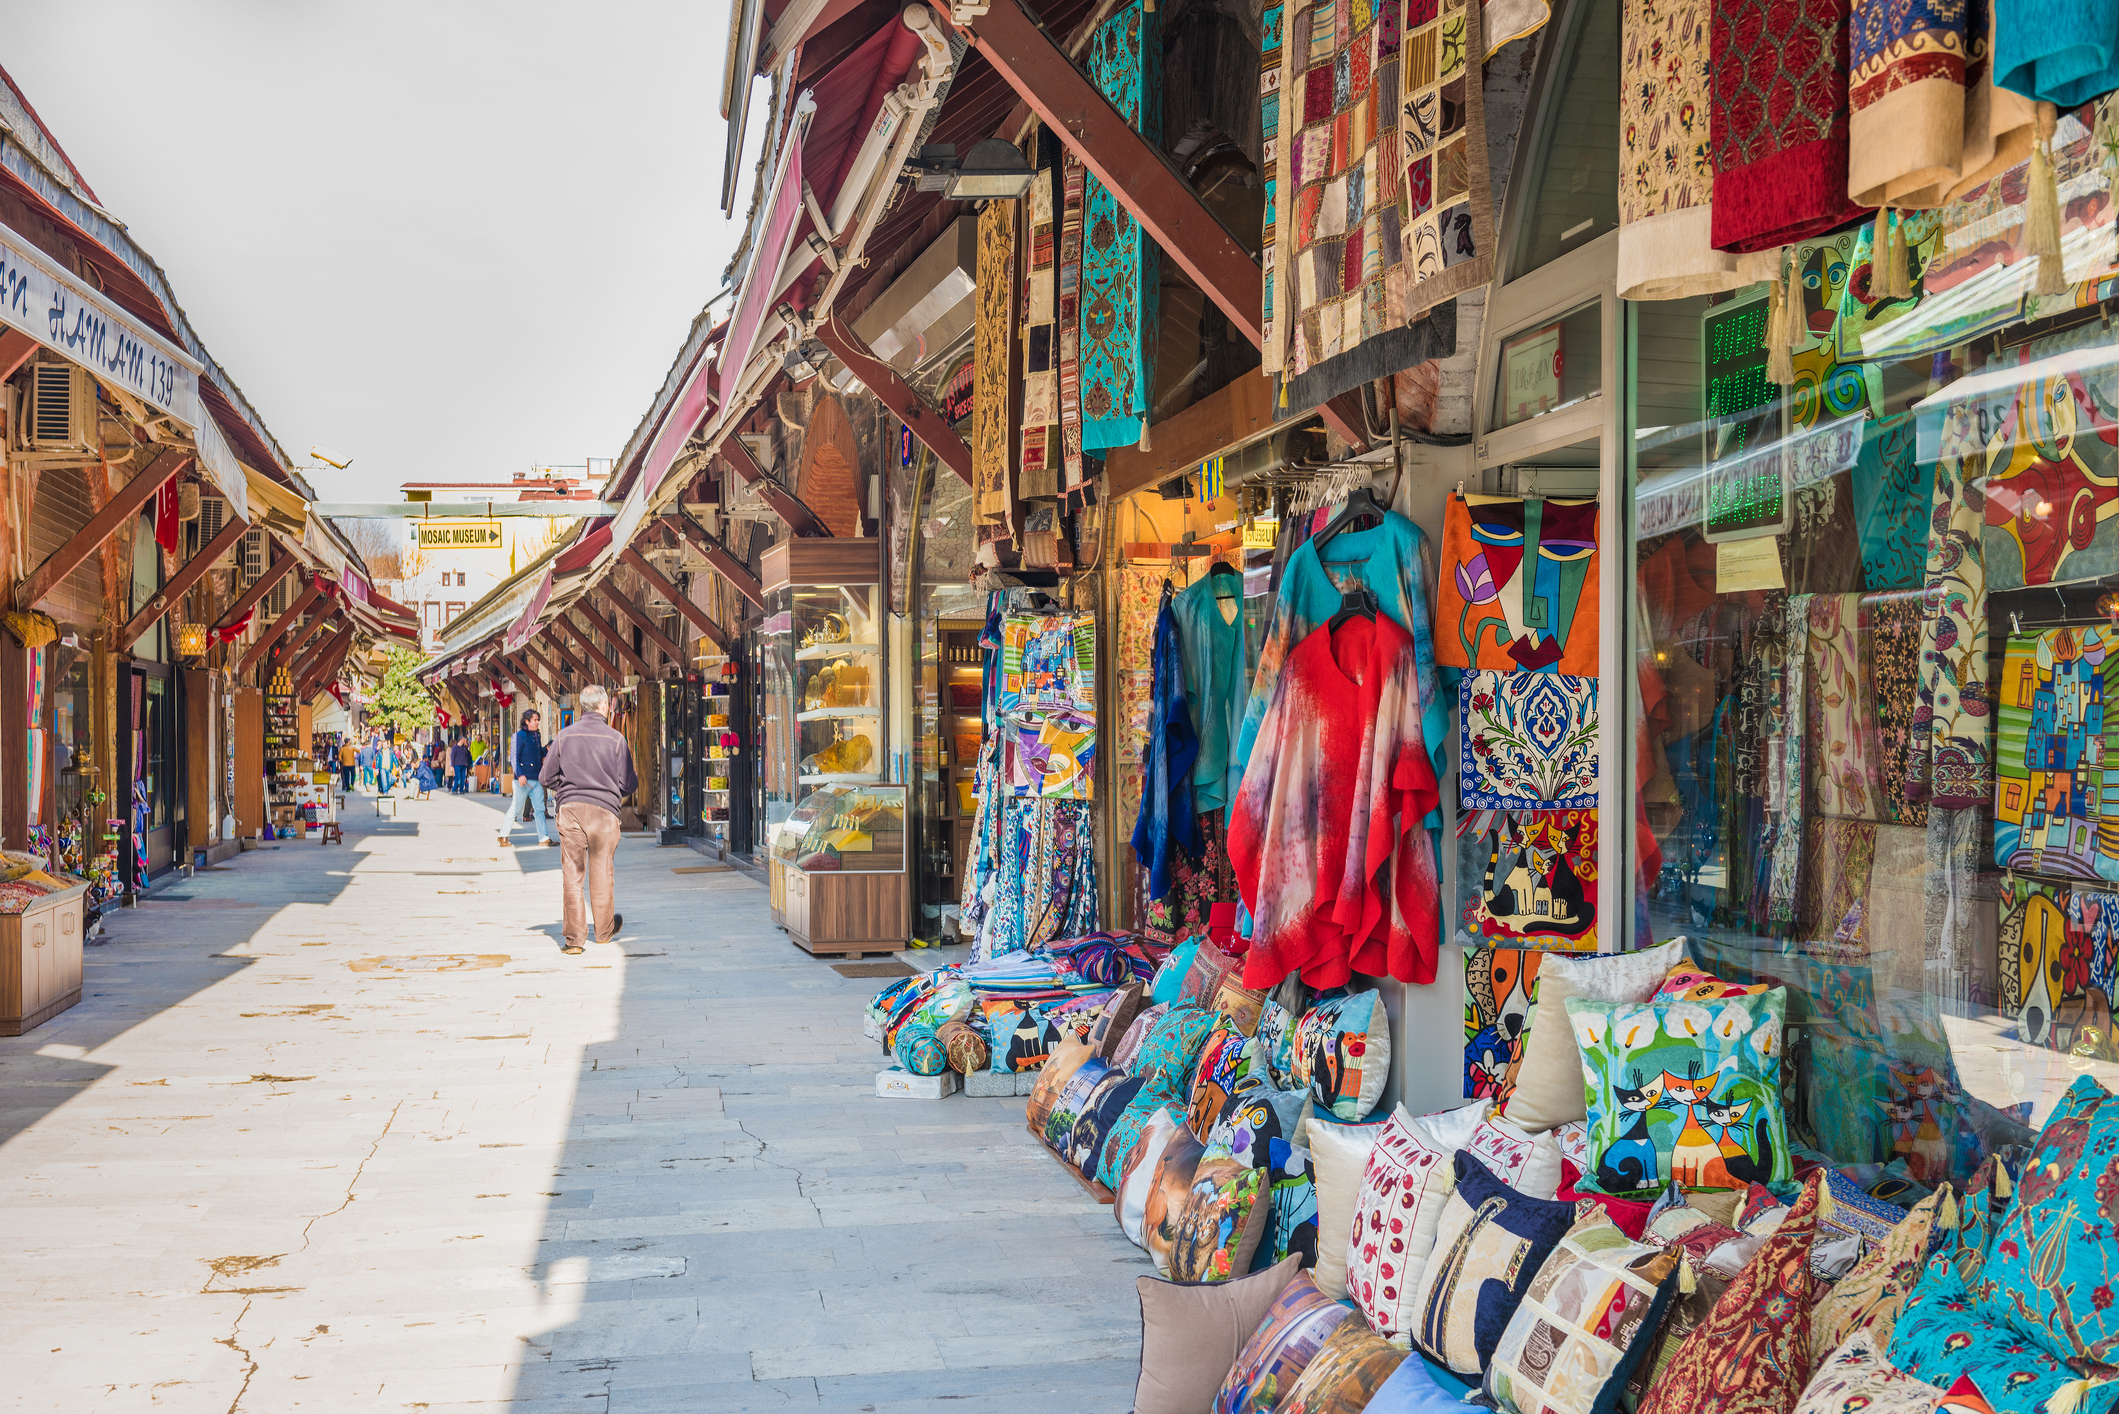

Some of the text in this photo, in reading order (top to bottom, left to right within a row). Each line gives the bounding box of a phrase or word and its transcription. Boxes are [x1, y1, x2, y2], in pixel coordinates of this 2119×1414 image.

[48, 291, 144, 389] HAMAM
[150, 354, 174, 407] 139
[1737, 424, 1747, 466] Y
[1710, 473, 1781, 526] BARATO
[421, 529, 486, 544] MOSAIC MUSEUM
